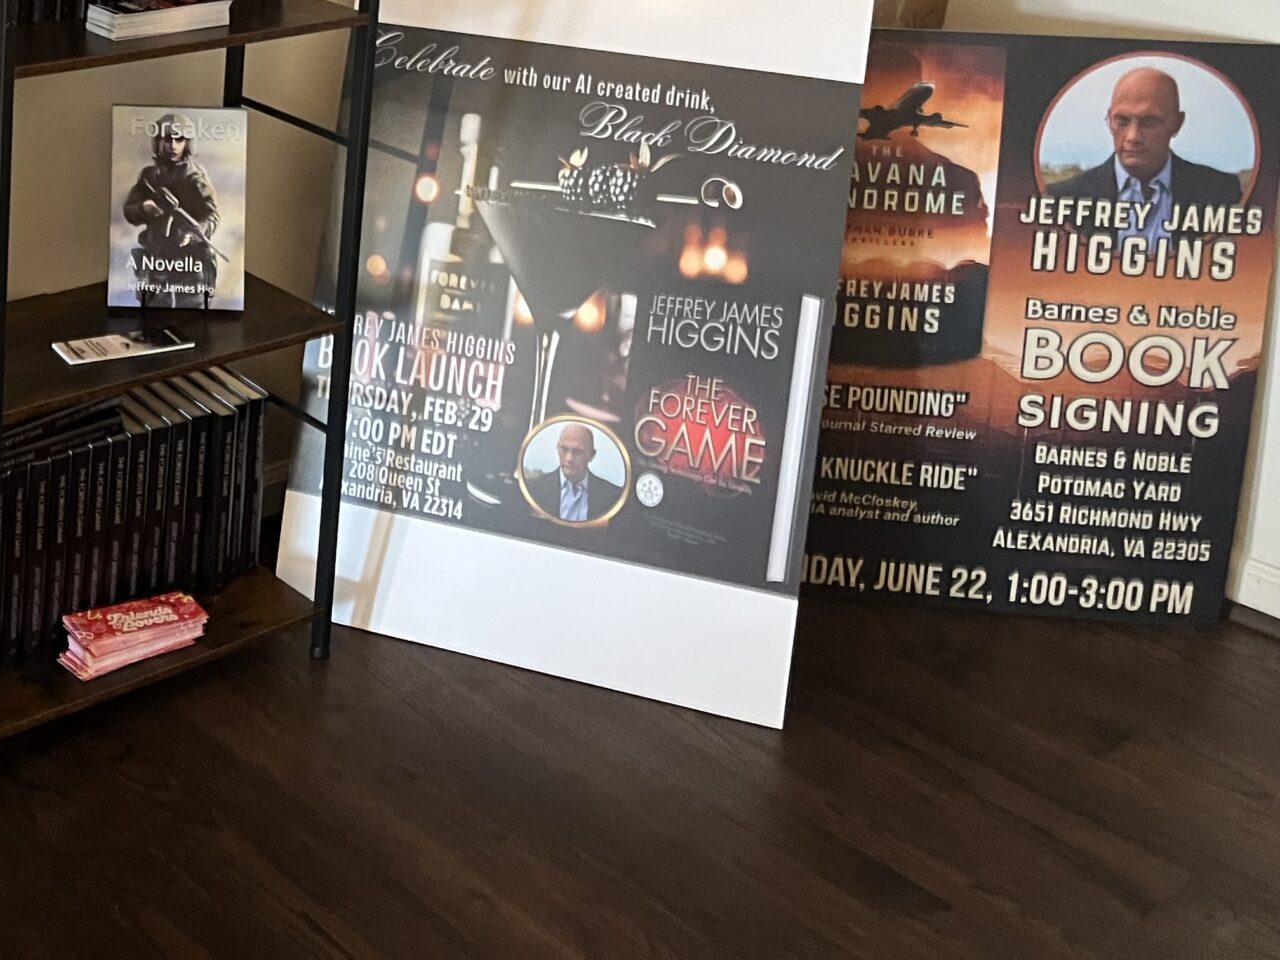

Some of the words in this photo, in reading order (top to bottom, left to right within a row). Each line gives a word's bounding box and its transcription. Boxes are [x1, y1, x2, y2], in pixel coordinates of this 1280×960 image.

[372, 30, 496, 82] Celebrate
[504, 66, 538, 87] with
[543, 74, 571, 93] our
[575, 73, 593, 95] AI
[597, 77, 660, 105] created
[665, 83, 716, 115] drink,
[131, 117, 240, 141] Forsaken
[579, 102, 683, 149] Black
[684, 116, 844, 171] Diamond
[872, 145, 903, 157] THE
[850, 162, 946, 187] AVANA
[848, 189, 965, 215] NDROME
[1019, 196, 1153, 231] JEFFREY
[1164, 203, 1263, 235] JAMES
[126, 255, 137, 270] A
[142, 255, 203, 272] Novella
[1030, 229, 1238, 281] HIGGINS
[163, 282, 195, 294] James
[887, 282, 955, 304] JAMES
[650, 294, 716, 321] JEFFREY
[720, 300, 784, 328] JAMES
[844, 303, 940, 334] GGINS
[1025, 297, 1119, 324] Barnes
[1128, 304, 1149, 325] &
[1158, 305, 1237, 331] Noble
[388, 321, 440, 351] JAMES
[447, 331, 516, 365] HIGGINS
[647, 315, 779, 360] HIGGINS
[318, 334, 390, 381] BOK
[396, 346, 505, 406] LAUNCH
[1021, 327, 1238, 391] BOOK
[317, 375, 416, 421] TRSDAY,
[424, 396, 463, 427] FEB.
[468, 405, 493, 432] 29
[686, 373, 723, 401] THE
[847, 386, 966, 417] POUNDING"
[649, 390, 757, 434] FOREVER
[822, 418, 865, 432] ournal
[870, 420, 921, 436] Starred
[925, 425, 977, 440] Review
[1017, 393, 1220, 439] SIGNING
[388, 422, 417, 450] PM
[421, 429, 457, 458] EDT
[635, 416, 766, 484] GAME
[349, 460, 375, 481] 208
[378, 467, 423, 492] Queen
[426, 477, 440, 496] St
[385, 449, 463, 482] Restaurant
[820, 456, 914, 486] KNUCKLE
[919, 462, 978, 490] RIDE"
[402, 490, 420, 511] VA
[423, 495, 463, 520] 22314
[829, 506, 881, 520] analyst
[883, 509, 910, 522] and
[913, 512, 960, 526] author
[840, 491, 918, 511] McCloskey,
[1009, 502, 1054, 525] 3651
[1122, 535, 1145, 559] VA
[1151, 538, 1211, 562] 22305
[801, 552, 865, 591] DAY,
[873, 558, 944, 595] JUNE
[949, 566, 993, 604] 22,
[1006, 569, 1144, 613] 1:00-3:00
[1150, 577, 1194, 615] PM
